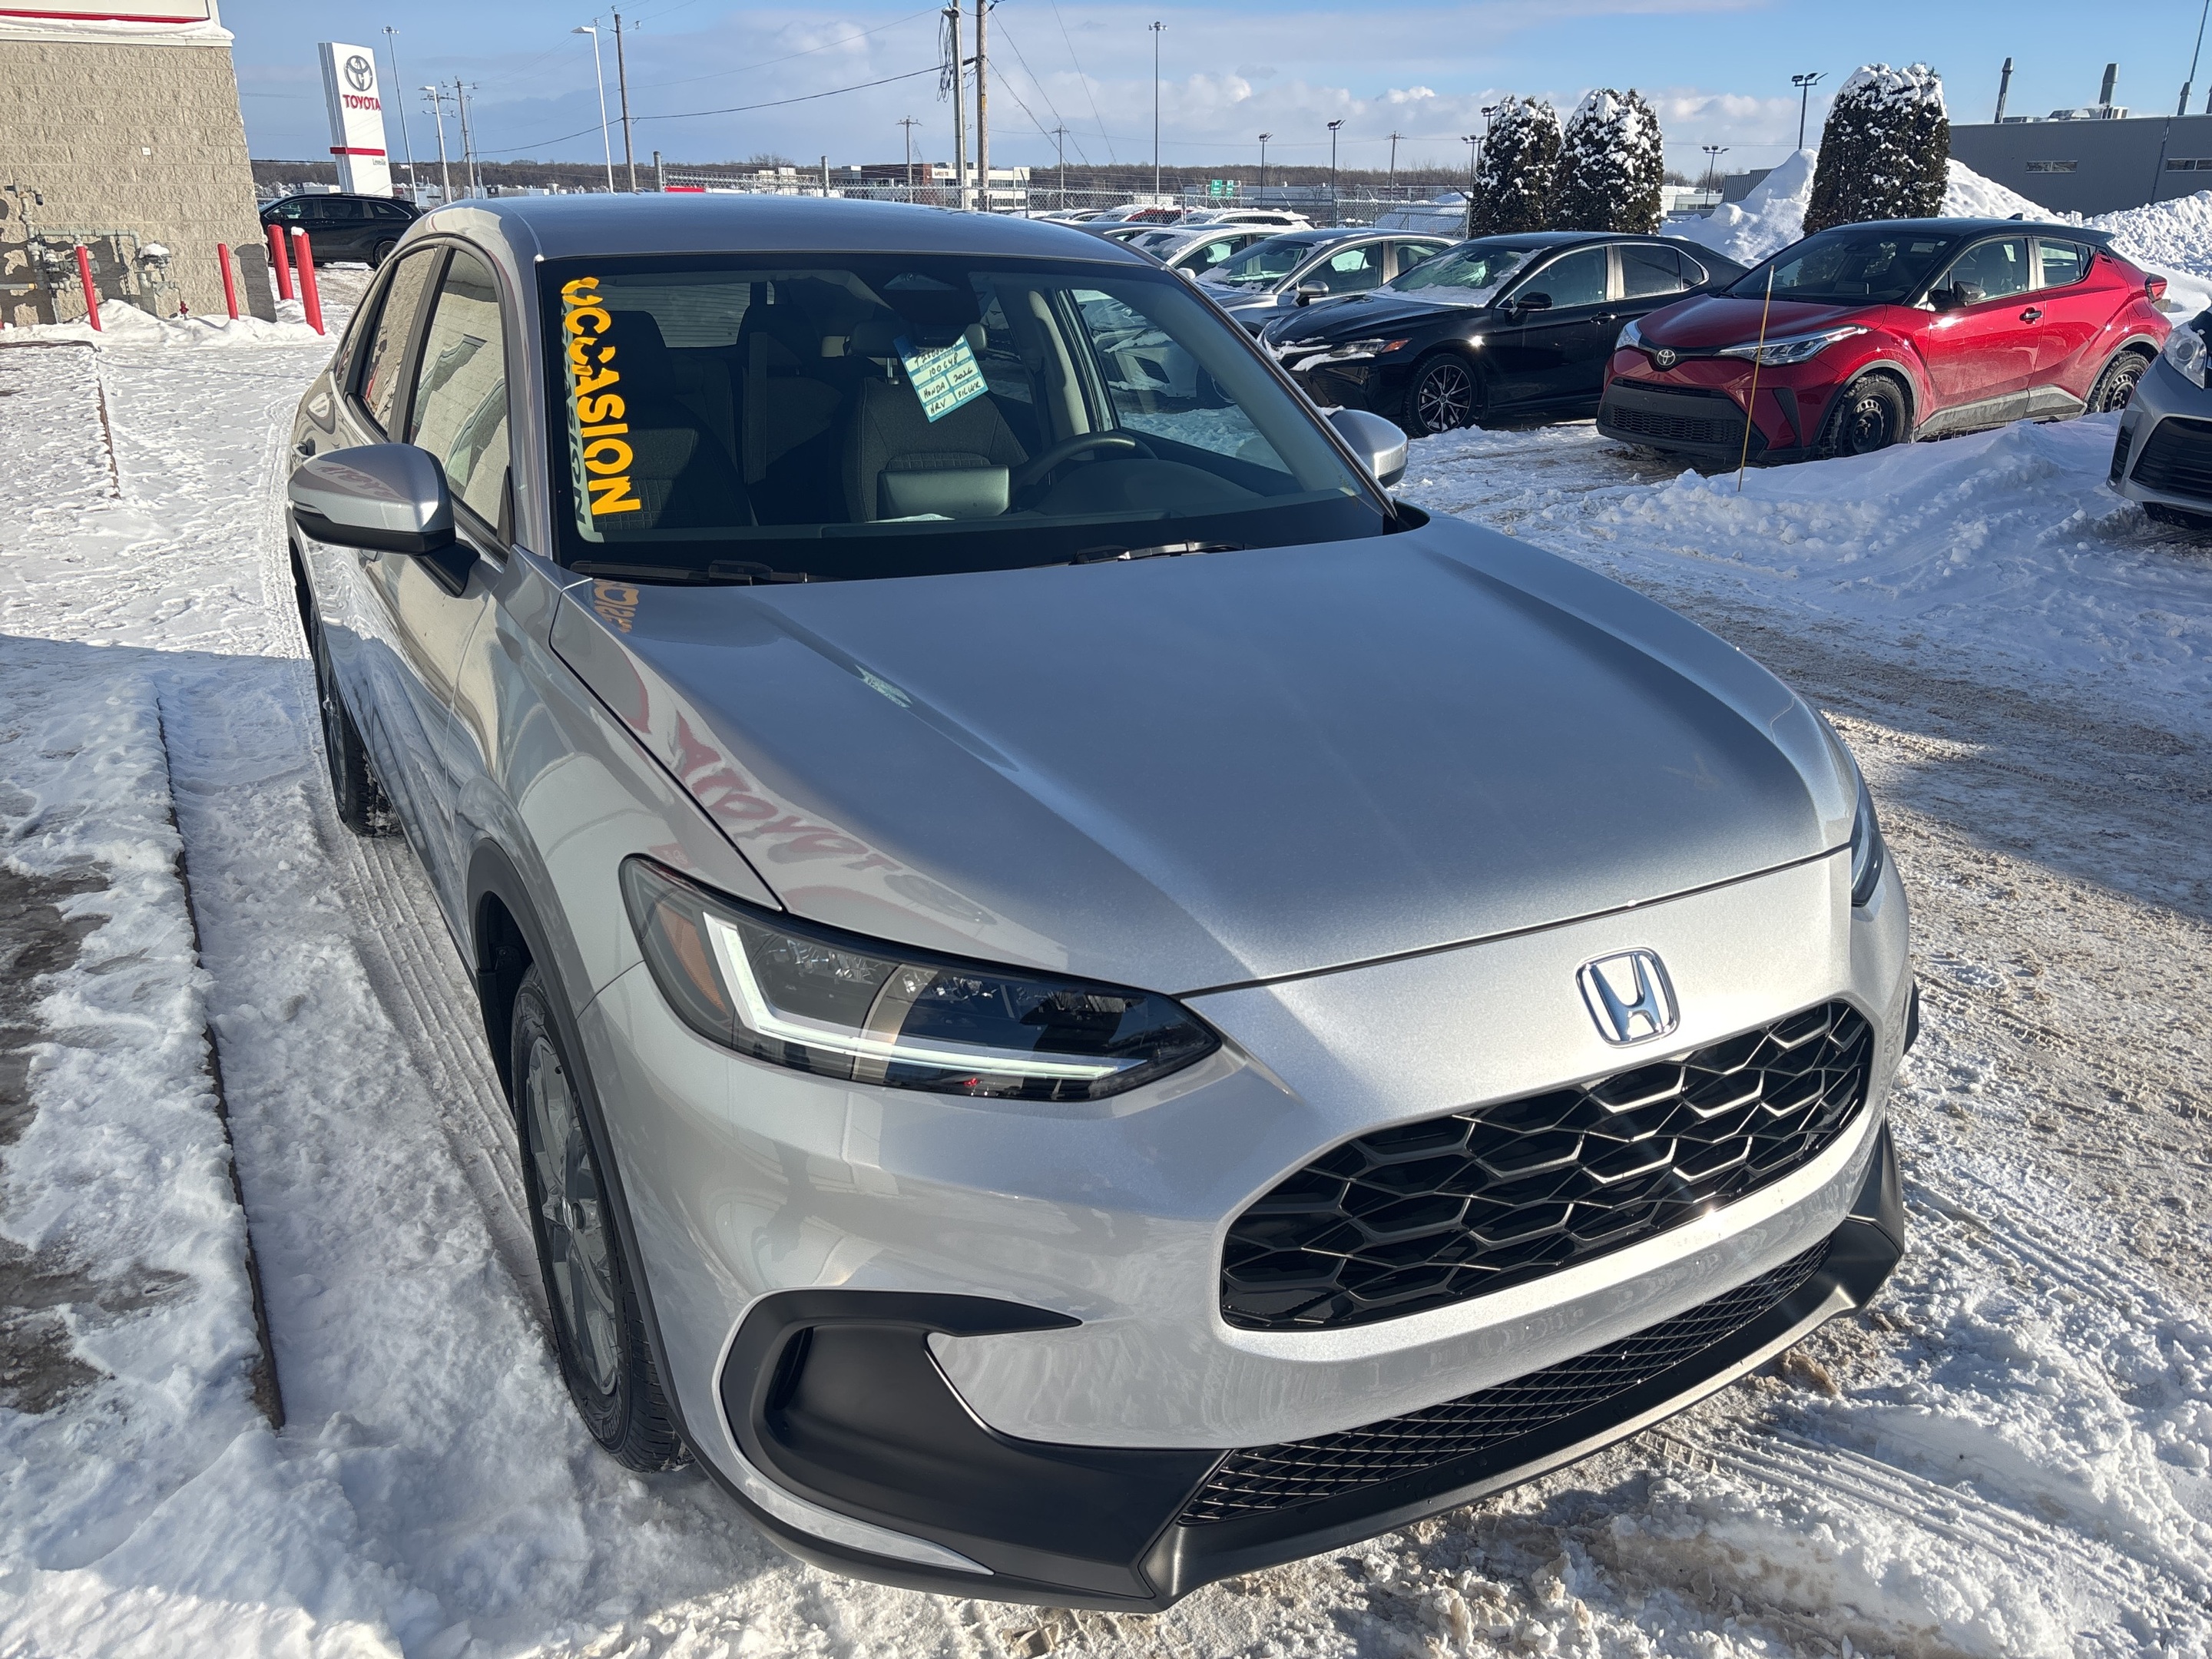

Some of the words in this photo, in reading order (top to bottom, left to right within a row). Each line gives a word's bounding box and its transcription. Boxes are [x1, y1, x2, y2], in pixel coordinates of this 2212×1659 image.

[343, 94, 381, 111] TOYOTA
[953, 367, 973, 382] 2026
[923, 381, 945, 399] HONDA
[958, 381, 982, 399] SILVER
[929, 398, 946, 415] HRV
